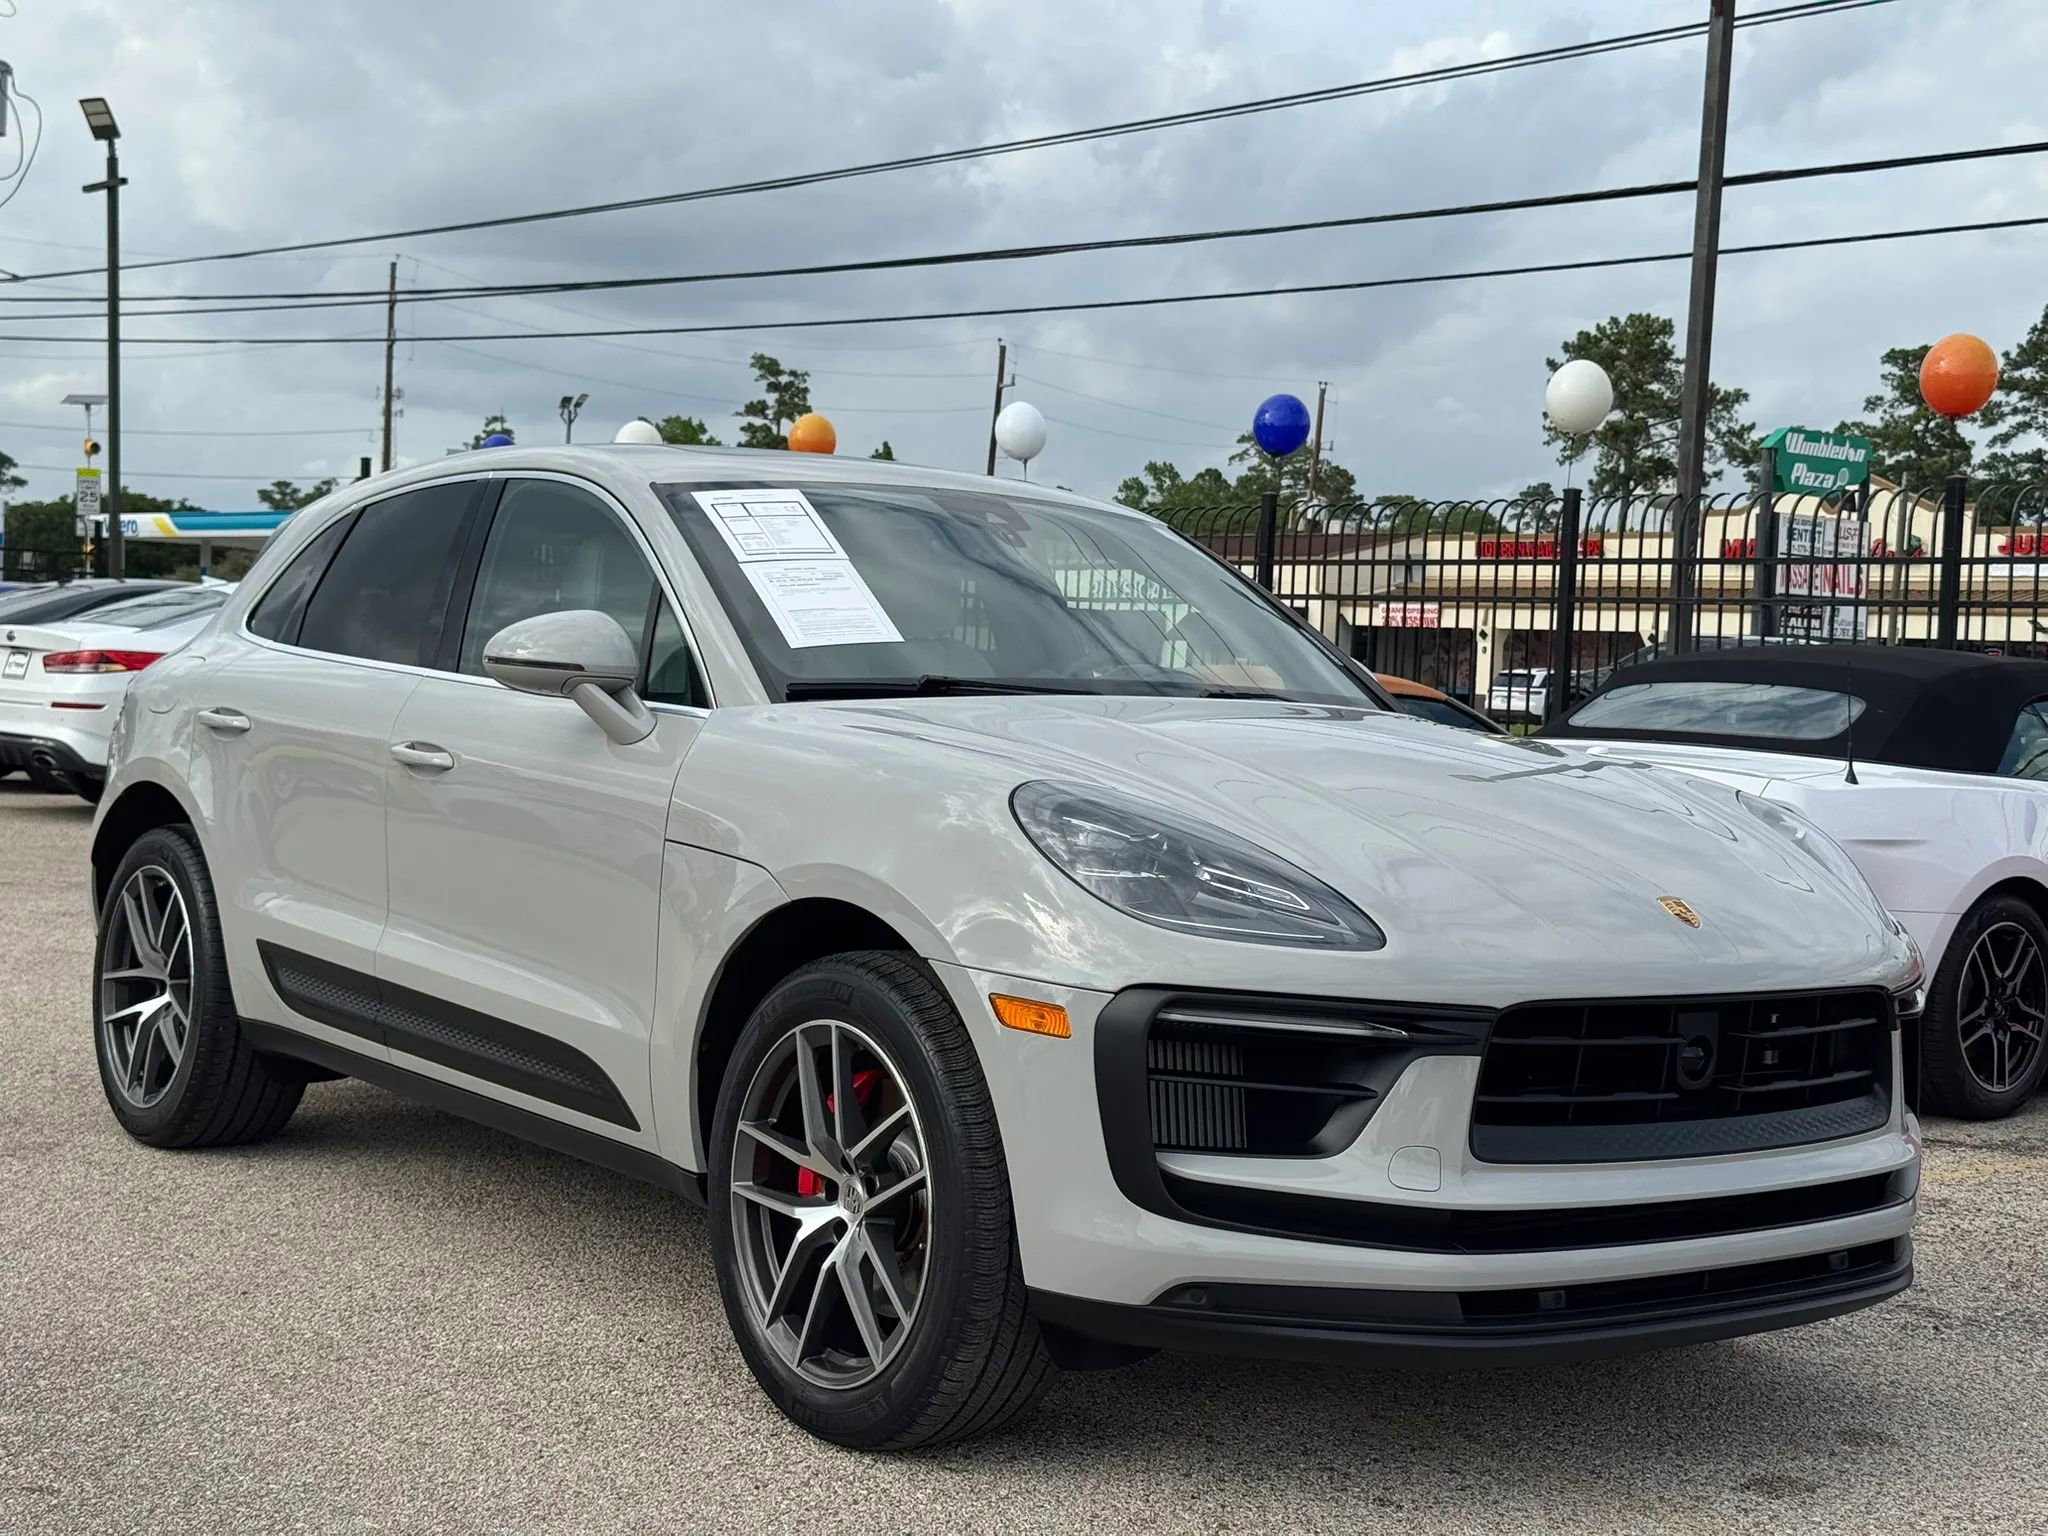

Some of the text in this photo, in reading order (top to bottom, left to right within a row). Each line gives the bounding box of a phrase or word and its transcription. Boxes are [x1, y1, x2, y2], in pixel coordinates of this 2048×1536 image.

[1785, 432, 1866, 463] Wimbledon
[1790, 462, 1836, 489] Plaza
[80, 491, 98, 503] 25
[104, 516, 138, 534] Vero
[1787, 526, 1822, 544] ENTIT
[1780, 563, 1819, 591] MSSAE
[1823, 563, 1864, 596] NAILS
[1381, 606, 1439, 615] GAN OPEING
